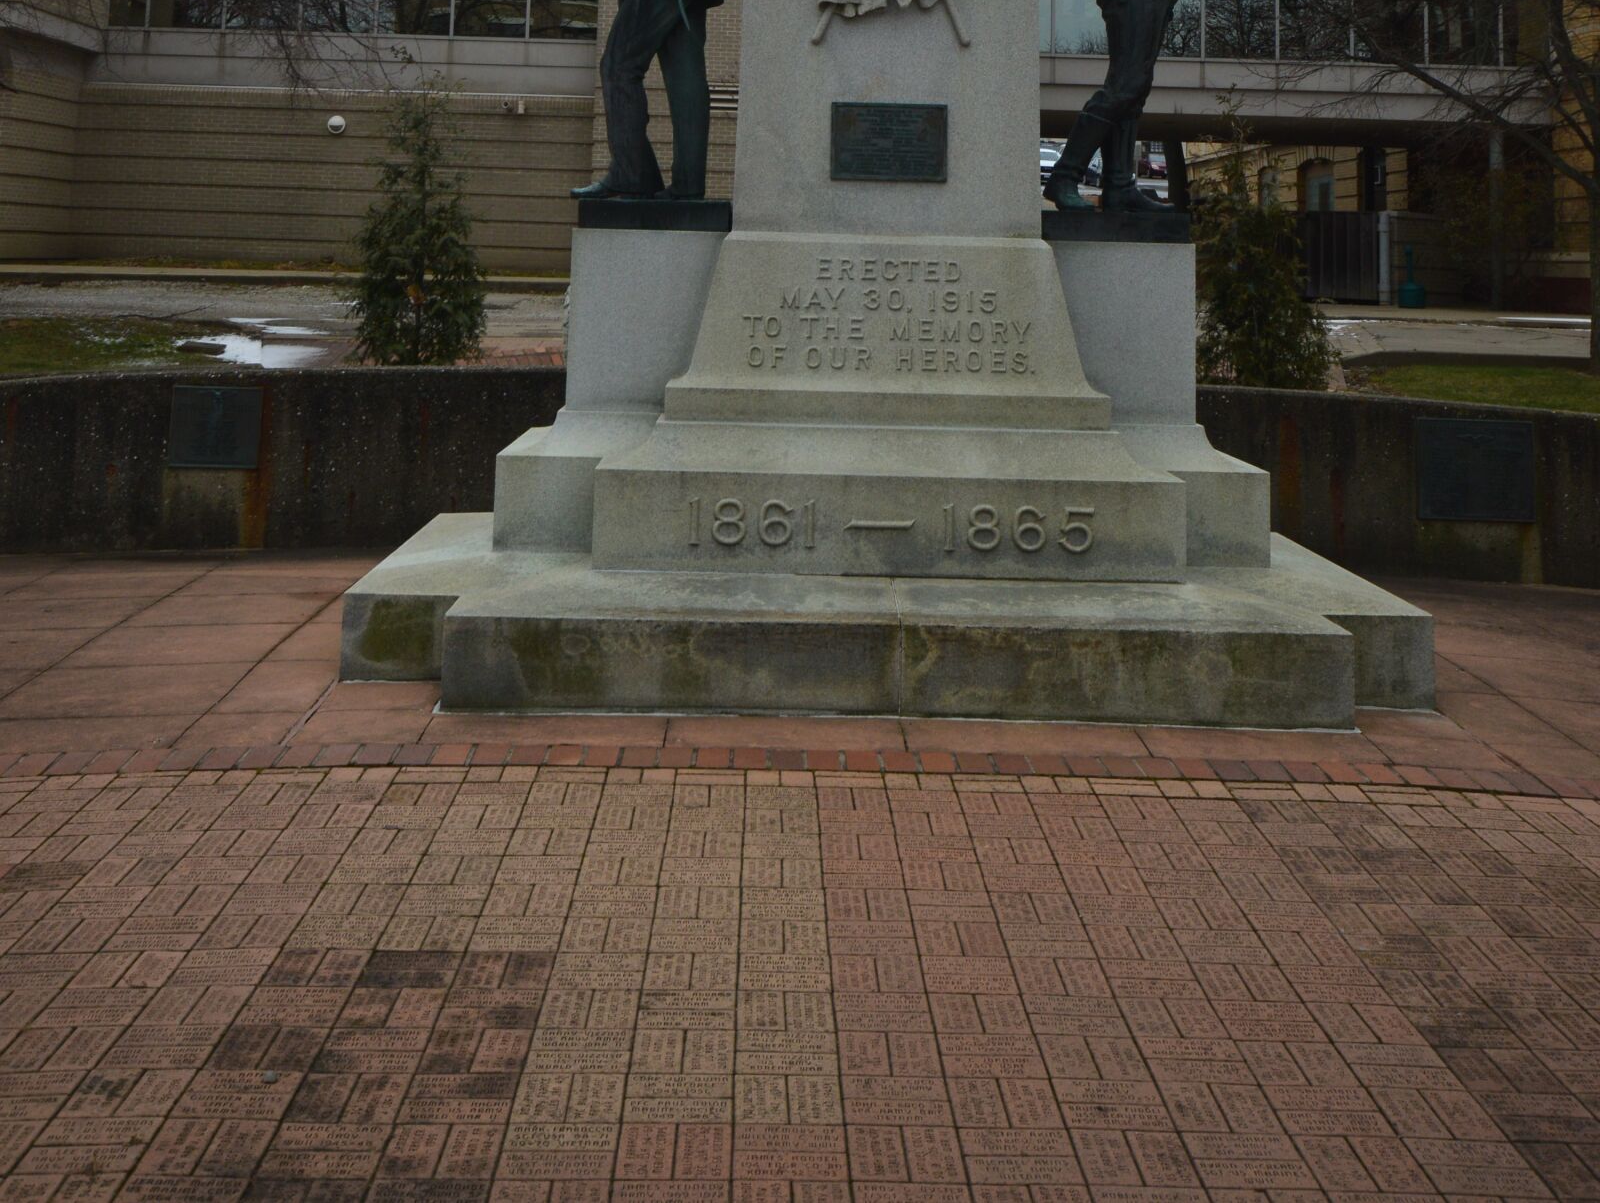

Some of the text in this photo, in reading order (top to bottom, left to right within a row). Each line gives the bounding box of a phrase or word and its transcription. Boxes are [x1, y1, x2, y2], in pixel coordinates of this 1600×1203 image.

[816, 257, 961, 282] ERECTED
[779, 288, 997, 313] MAY 30, 1915
[743, 315, 1032, 344] TO THE MEMORY
[746, 346, 1035, 374] OF OUR HEROES.
[688, 498, 816, 549] 1861
[943, 504, 1095, 553] 1865
